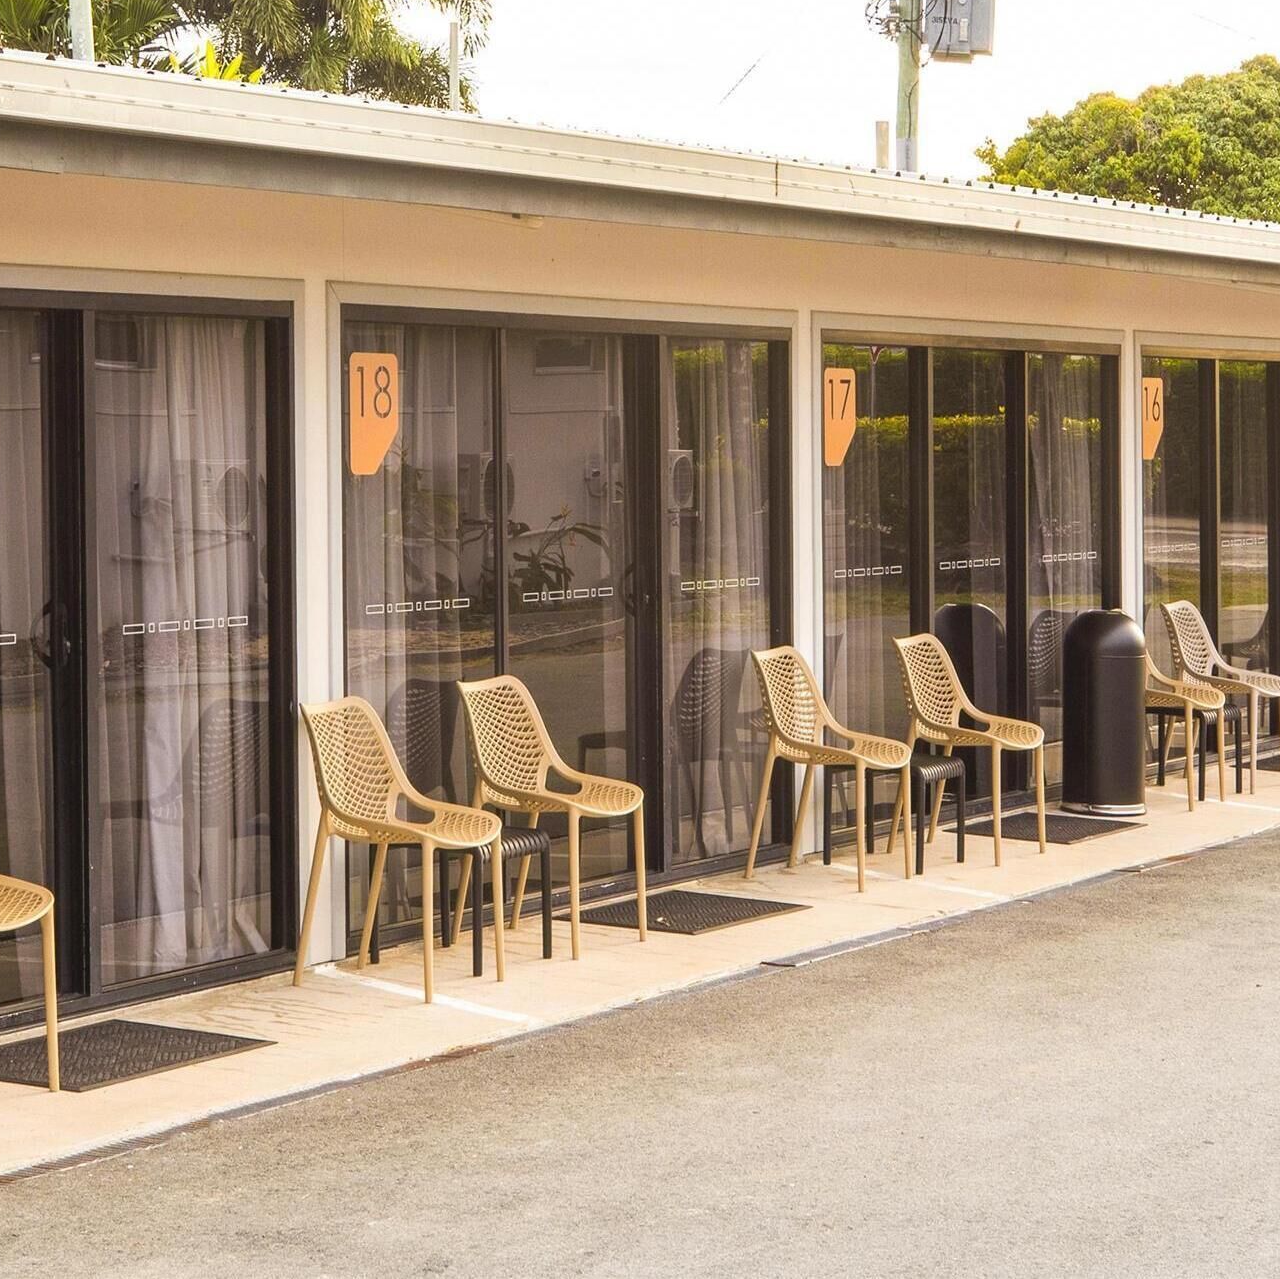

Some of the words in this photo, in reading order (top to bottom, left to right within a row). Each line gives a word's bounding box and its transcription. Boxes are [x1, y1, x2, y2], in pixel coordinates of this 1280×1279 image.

[356, 365, 392, 419] 18
[828, 379, 851, 420] 17
[1144, 386, 1160, 422] 16
